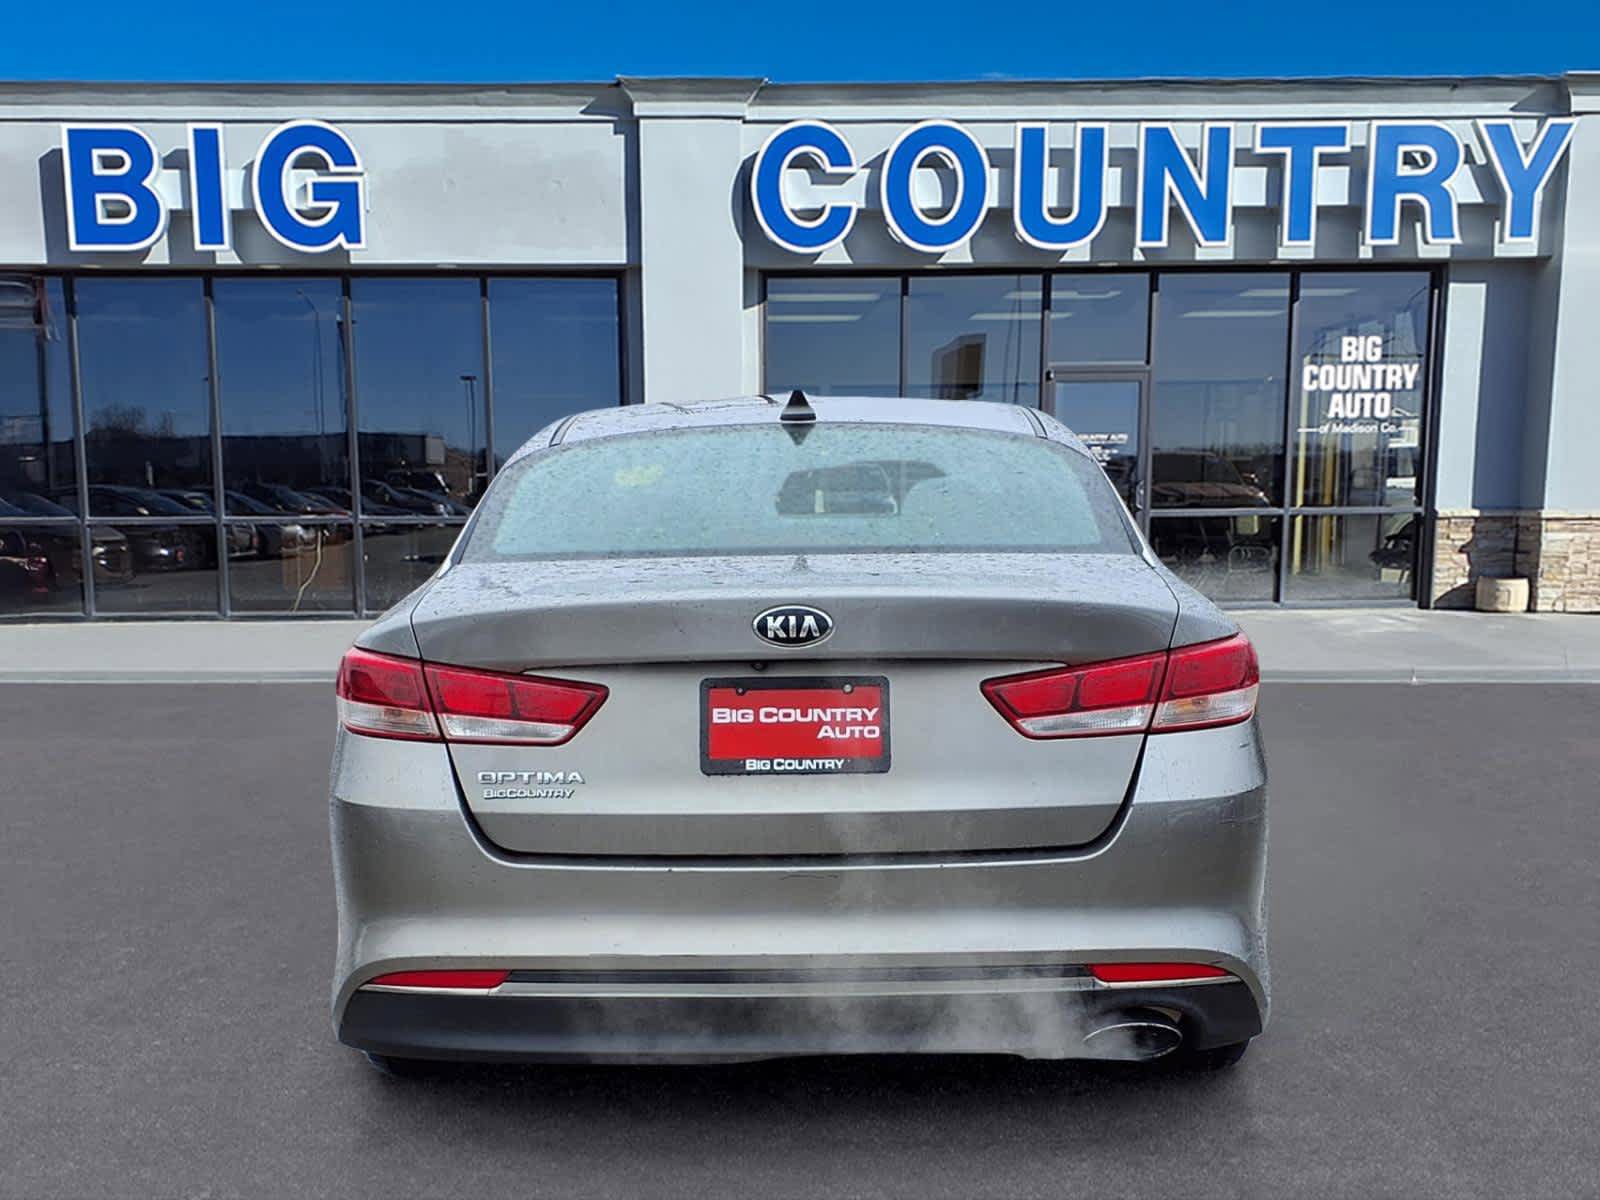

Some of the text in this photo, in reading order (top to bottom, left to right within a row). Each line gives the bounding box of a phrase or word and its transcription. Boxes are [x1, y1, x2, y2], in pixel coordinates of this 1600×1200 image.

[61, 119, 1577, 254] BIG COUNTRY
[1341, 335, 1383, 363] BIG
[1303, 364, 1420, 391] COUNTRY
[1327, 392, 1392, 419] AUTO
[766, 615, 820, 638] KIA
[759, 707, 880, 724] COUNTRY
[816, 725, 881, 739] AUTO
[773, 758, 845, 771] COUNTRY
[478, 771, 585, 785] OPTIMA
